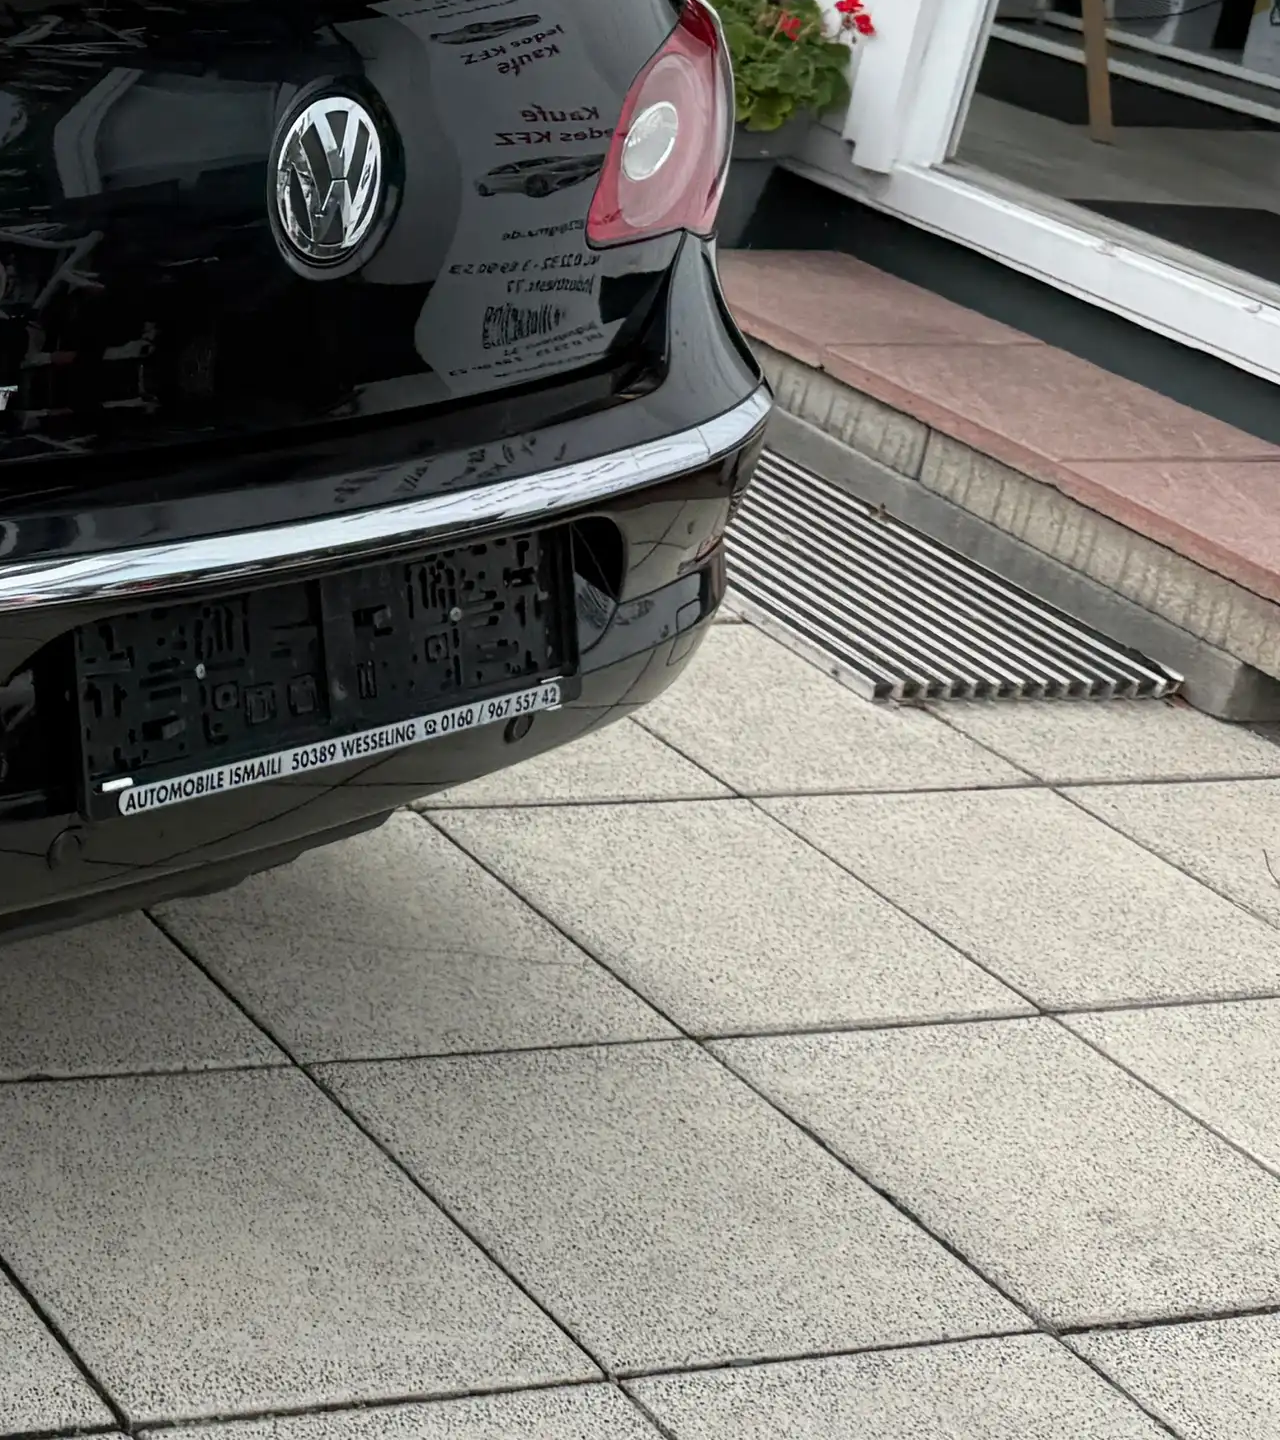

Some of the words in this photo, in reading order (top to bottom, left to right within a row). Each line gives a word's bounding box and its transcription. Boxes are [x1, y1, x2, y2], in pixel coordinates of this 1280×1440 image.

[125, 771, 224, 812] AUTOMOBILE
[229, 756, 282, 785] ISMAILI
[291, 744, 336, 771] 50389
[340, 724, 416, 758] WESSELING
[441, 711, 473, 732] 0160
[488, 699, 512, 719] 967
[515, 691, 538, 713] 557
[541, 688, 558, 705] 42
